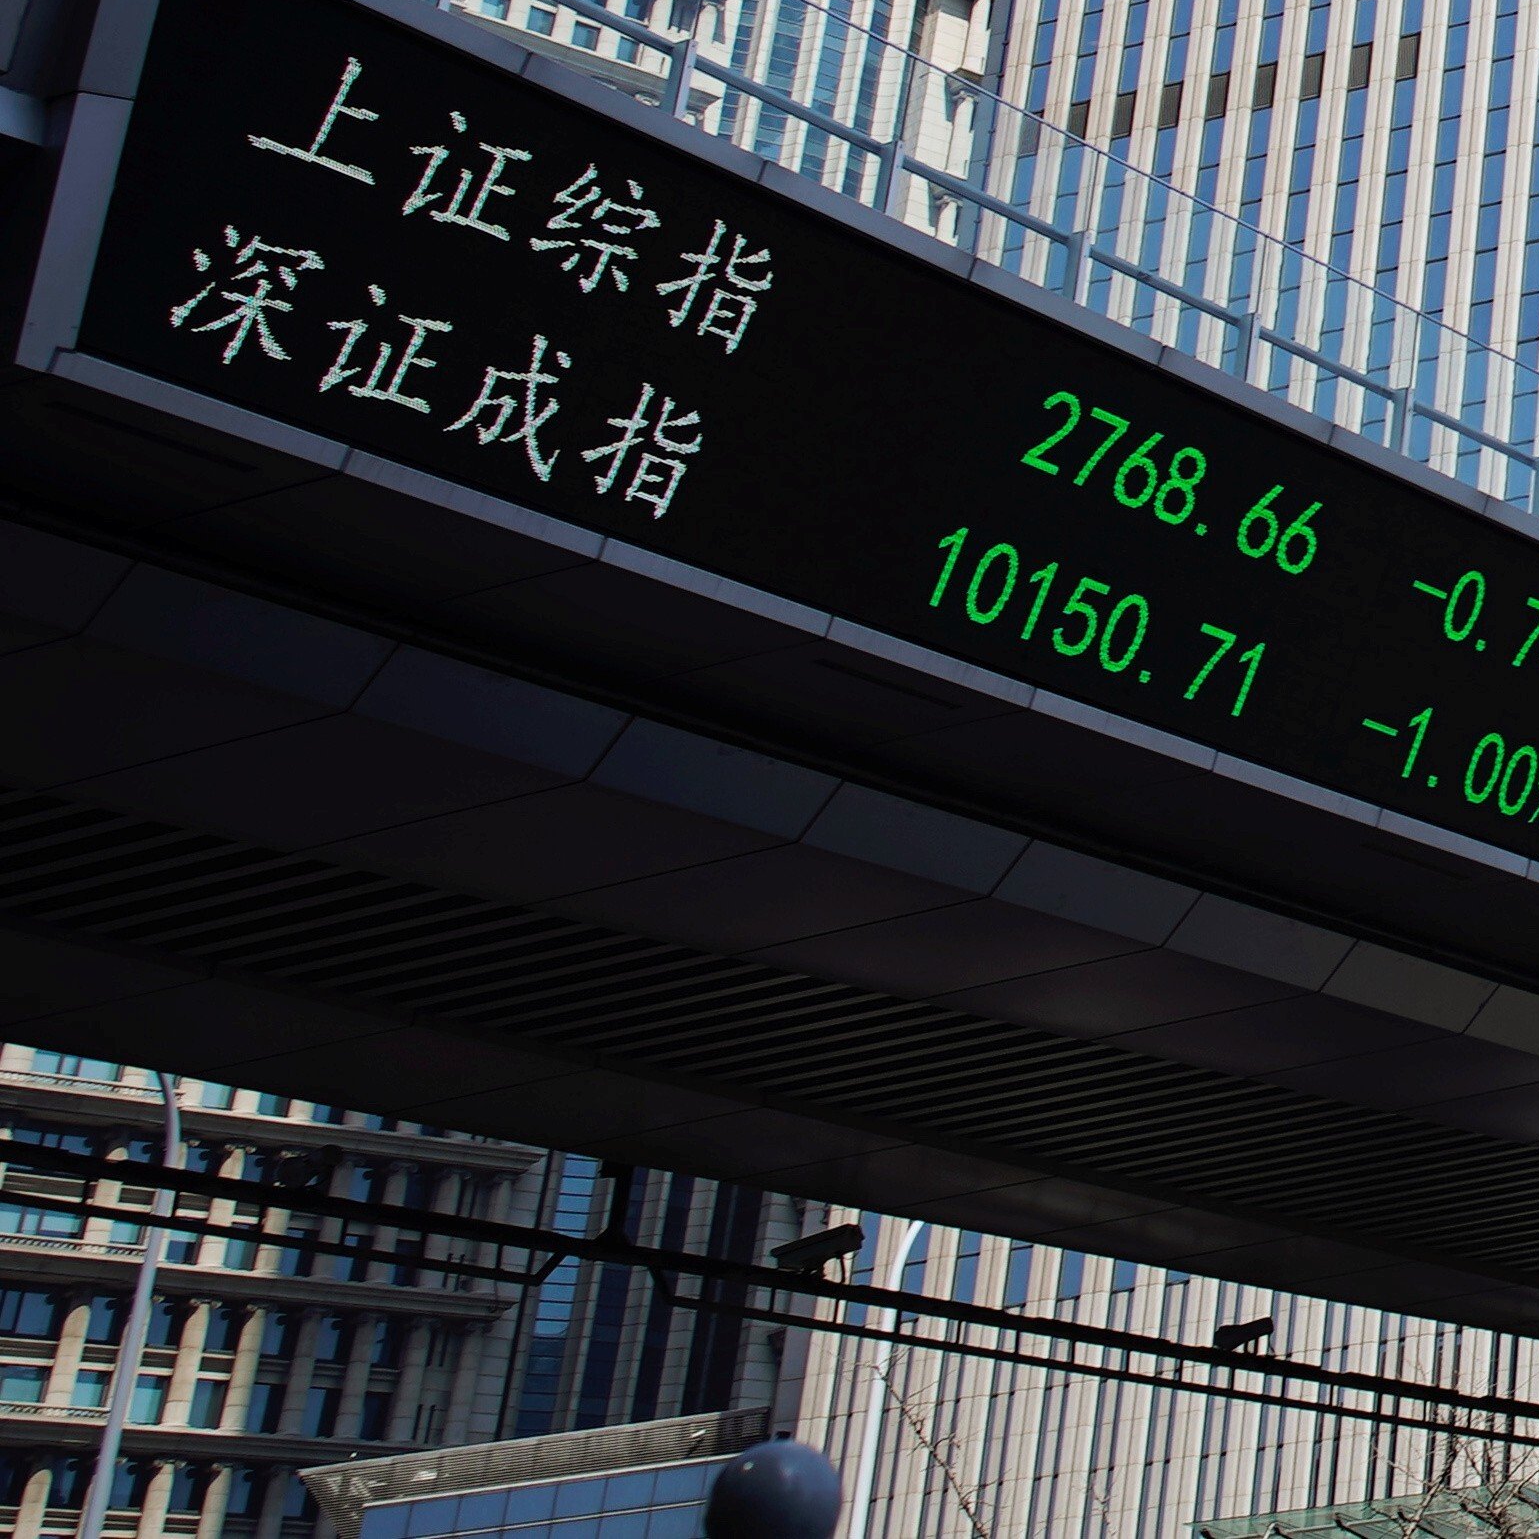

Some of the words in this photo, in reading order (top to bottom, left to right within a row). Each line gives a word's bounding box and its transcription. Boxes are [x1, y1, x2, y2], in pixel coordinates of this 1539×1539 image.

[170, 224, 703, 520] 深证成指
[929, 527, 1266, 717] 10150.71
[247, 56, 774, 355] 上证综指
[1021, 390, 1323, 575] 2768.66
